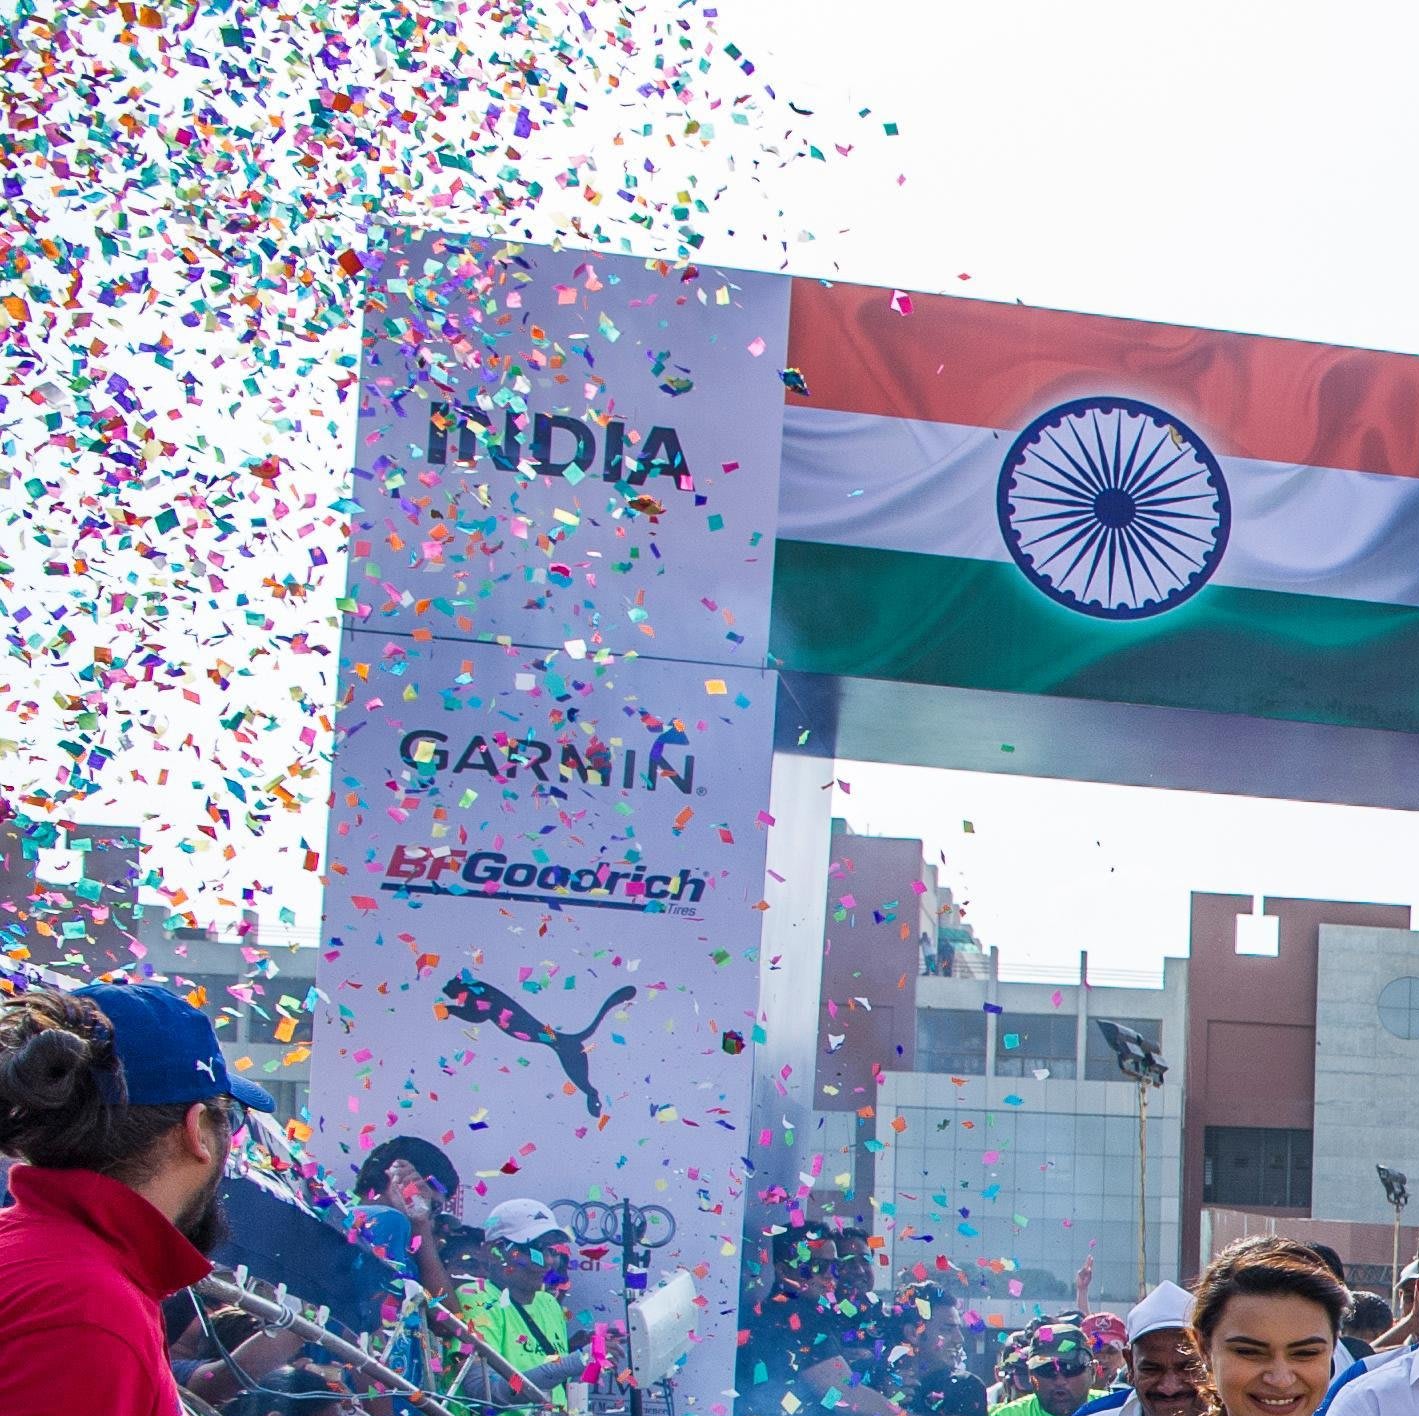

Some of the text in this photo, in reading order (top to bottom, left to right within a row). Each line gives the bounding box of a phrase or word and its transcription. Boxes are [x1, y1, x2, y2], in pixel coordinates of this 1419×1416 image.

[426, 400, 696, 492] INDIA
[399, 728, 696, 796] GARMIN
[386, 845, 706, 903] BFGoodrich
[665, 903, 696, 917] Tires
